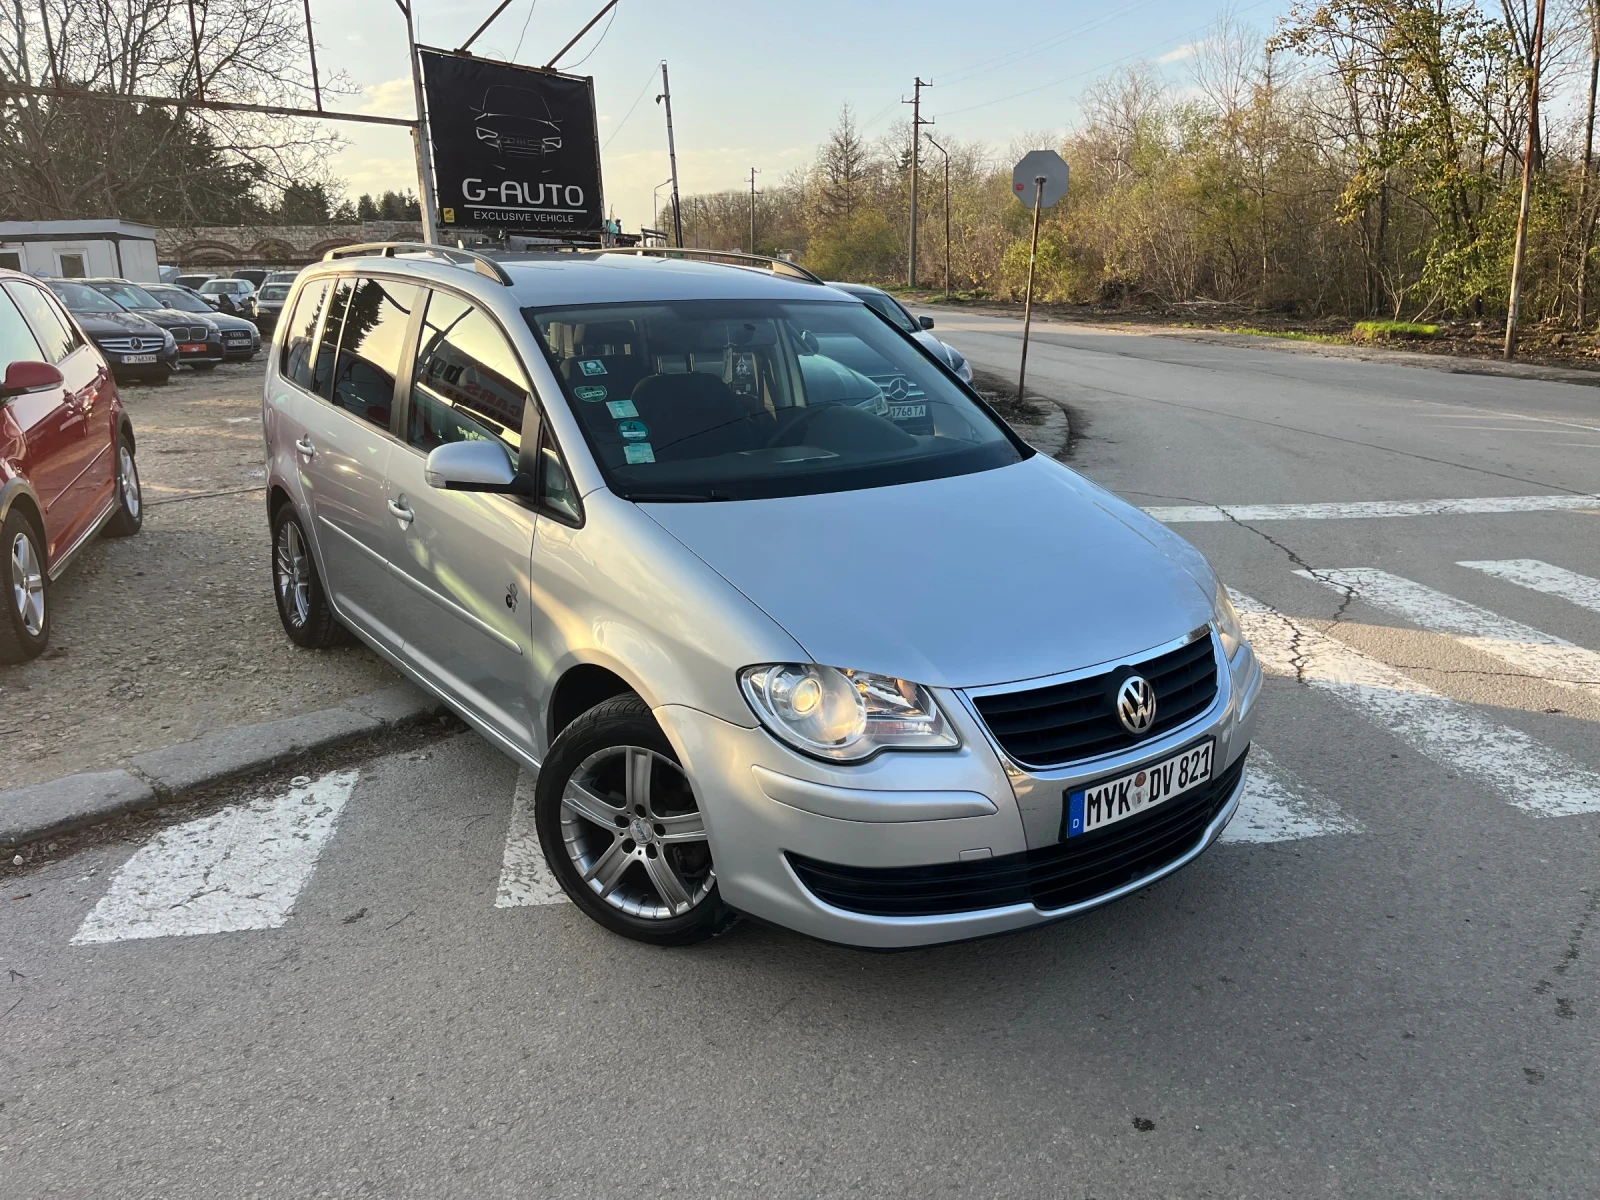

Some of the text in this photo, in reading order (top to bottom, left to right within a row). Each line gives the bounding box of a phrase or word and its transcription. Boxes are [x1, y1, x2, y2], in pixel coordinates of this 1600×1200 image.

[461, 177, 585, 207] G-AUTO
[473, 210, 575, 223] EXCLUSIVE VEHICLE
[891, 405, 924, 417] 1768 TA
[628, 421, 637, 431] 4
[1072, 745, 1210, 829] D MYK DV 821
